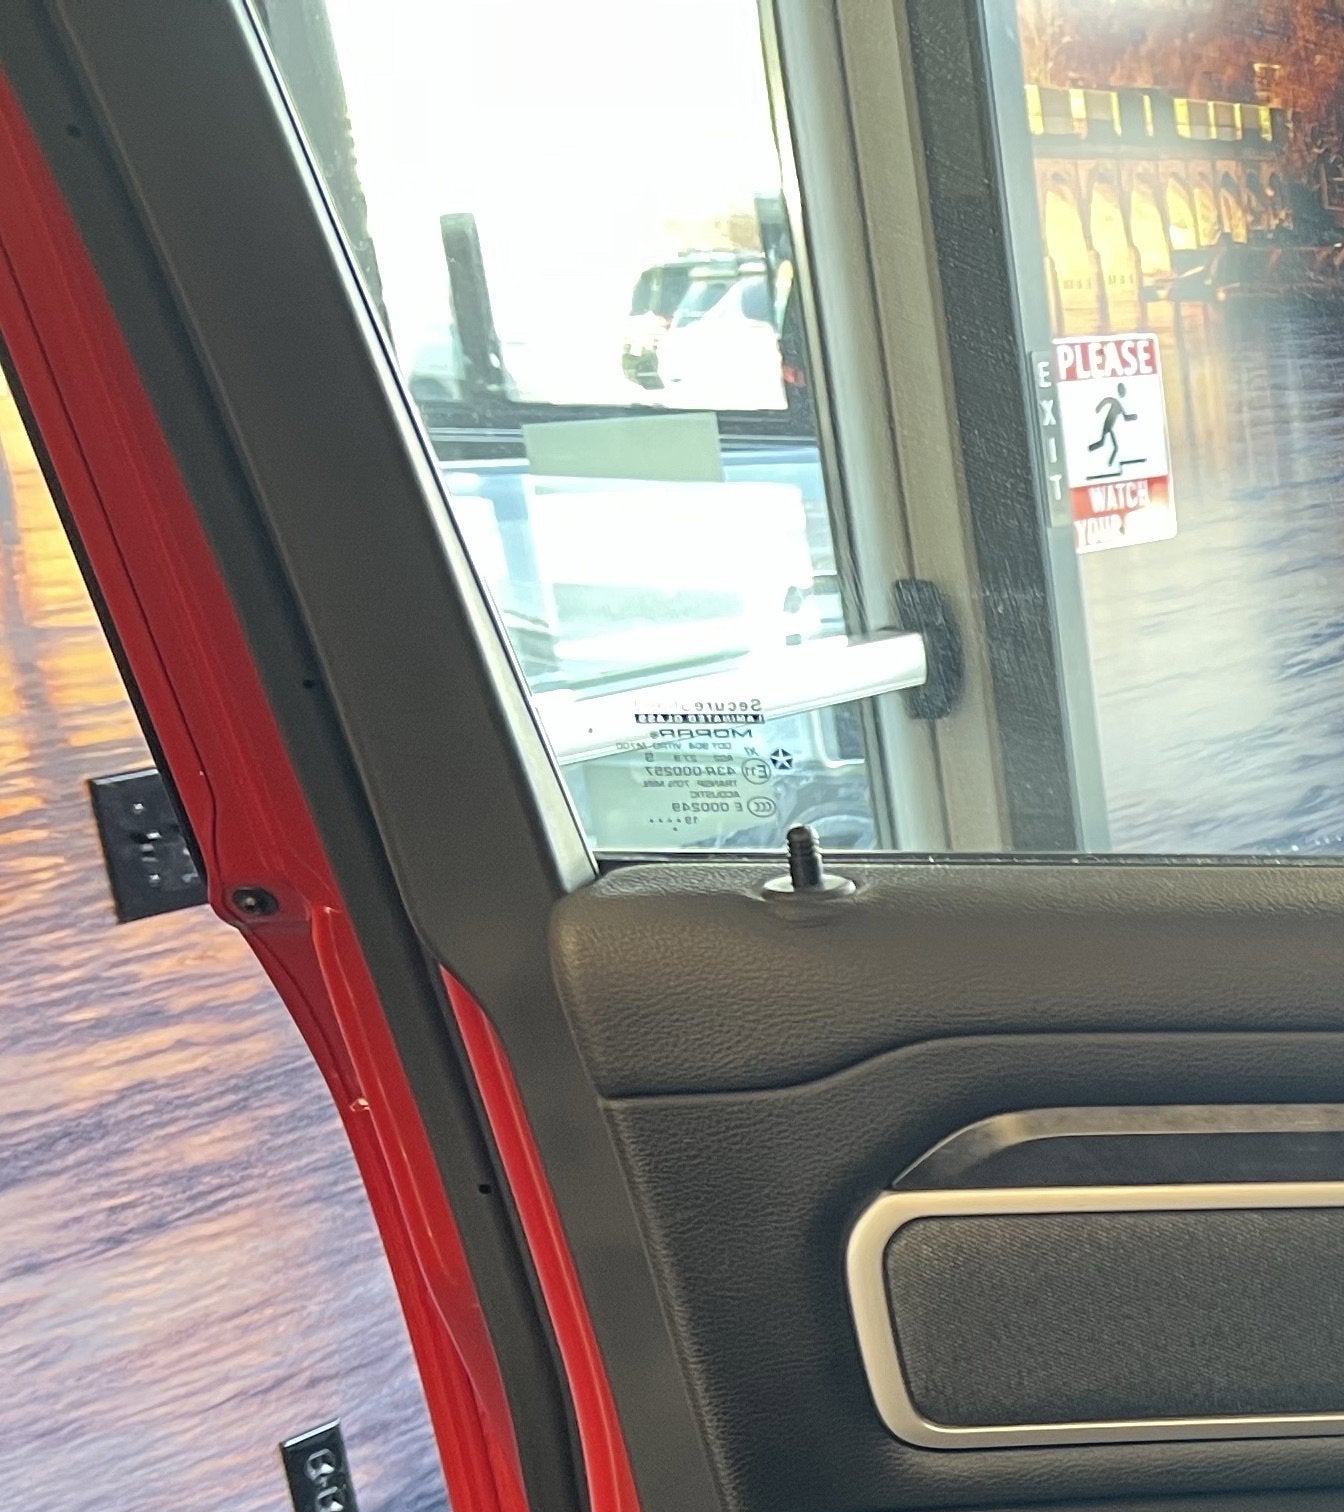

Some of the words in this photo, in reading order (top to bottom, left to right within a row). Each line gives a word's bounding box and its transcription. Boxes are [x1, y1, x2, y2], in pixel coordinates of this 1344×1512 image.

[1056, 339, 1153, 381] PLEASE
[1036, 361, 1062, 500] EXIT
[1087, 480, 1149, 513] WATCH
